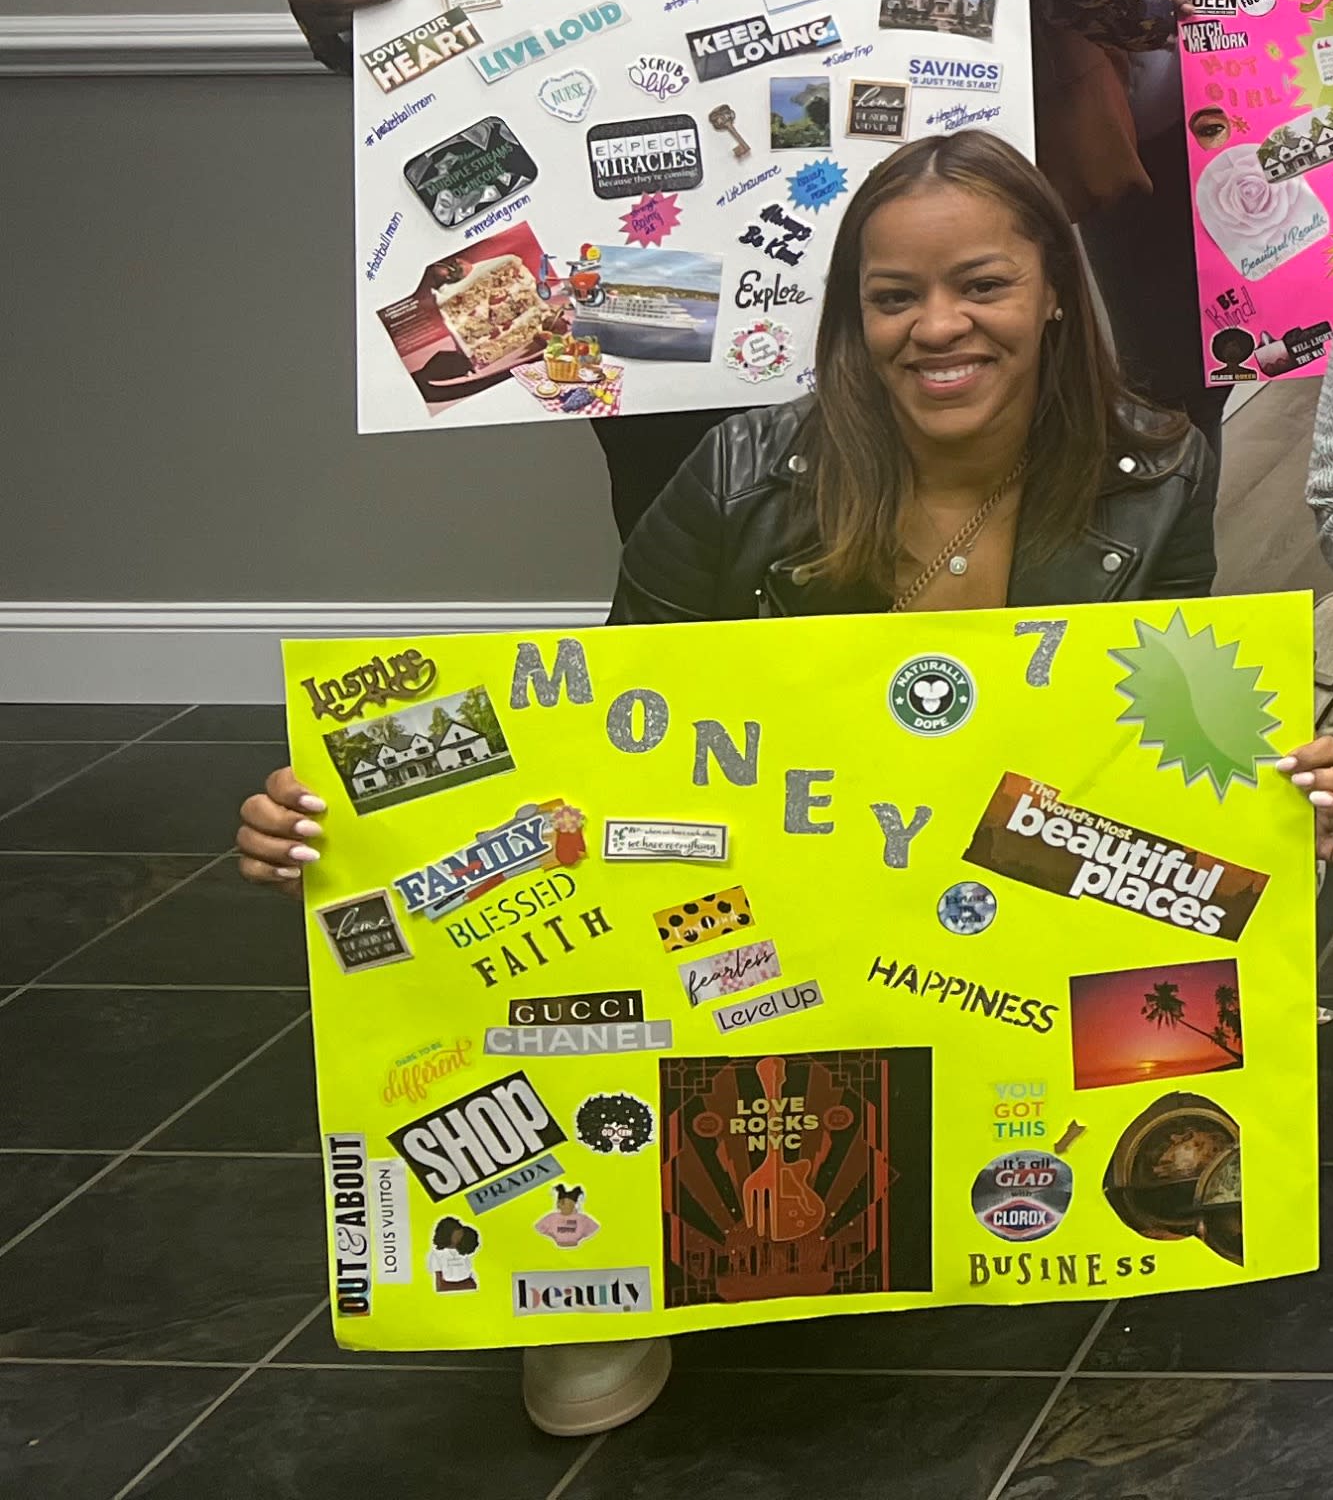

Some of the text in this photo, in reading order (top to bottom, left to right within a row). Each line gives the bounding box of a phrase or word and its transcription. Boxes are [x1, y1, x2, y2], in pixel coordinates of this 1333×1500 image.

[363, 17, 451, 67] LOVE YOUR
[479, 2, 623, 79] LIVE LOUD
[693, 20, 767, 57] KEEP
[1181, 21, 1224, 40] WATCH
[1188, 32, 1248, 52] ME WORK
[373, 19, 477, 91] HEART
[639, 57, 684, 77] SCRUB
[909, 59, 999, 80] SAVINGS
[594, 148, 697, 179] MIRACLES
[595, 133, 693, 157] EXPECT
[1216, 288, 1239, 311] BE
[1013, 617, 1069, 688] 7
[300, 647, 437, 722] Inspire
[897, 661, 968, 688] NATURALLY
[913, 715, 951, 732] DOPE
[510, 636, 934, 870] MONEY
[1027, 779, 1058, 804] The
[1039, 794, 1133, 842] World's Most
[395, 816, 552, 907] FAMILY
[1005, 794, 1226, 904] beautiful
[446, 871, 578, 949] BLESSED
[1069, 859, 1227, 937] places
[470, 906, 615, 988] FAITH
[684, 947, 778, 1003] fearless
[514, 996, 638, 1025] GUCCI
[717, 984, 819, 1031] Level Up
[866, 955, 1061, 1035] HAPPINESS
[486, 1022, 668, 1054] CHANEL
[381, 1037, 474, 1105] different
[736, 1097, 805, 1115] LOVE
[992, 1082, 1047, 1100] YOU
[728, 1113, 820, 1134] ROCKS
[993, 1100, 1047, 1120] GOT
[401, 1077, 551, 1198] SHOP
[747, 1133, 803, 1152] NYC
[994, 1119, 1047, 1140] THIS
[335, 1136, 368, 1228] ABOUT
[994, 1168, 1055, 1188] GLAD
[1002, 1157, 1026, 1171] It's
[474, 1160, 553, 1207] PRADA
[379, 1168, 399, 1274] LOUIS VUITTON
[992, 1208, 1048, 1227] CLOROX
[335, 1256, 370, 1315] OUT
[516, 1276, 646, 1313] beauty
